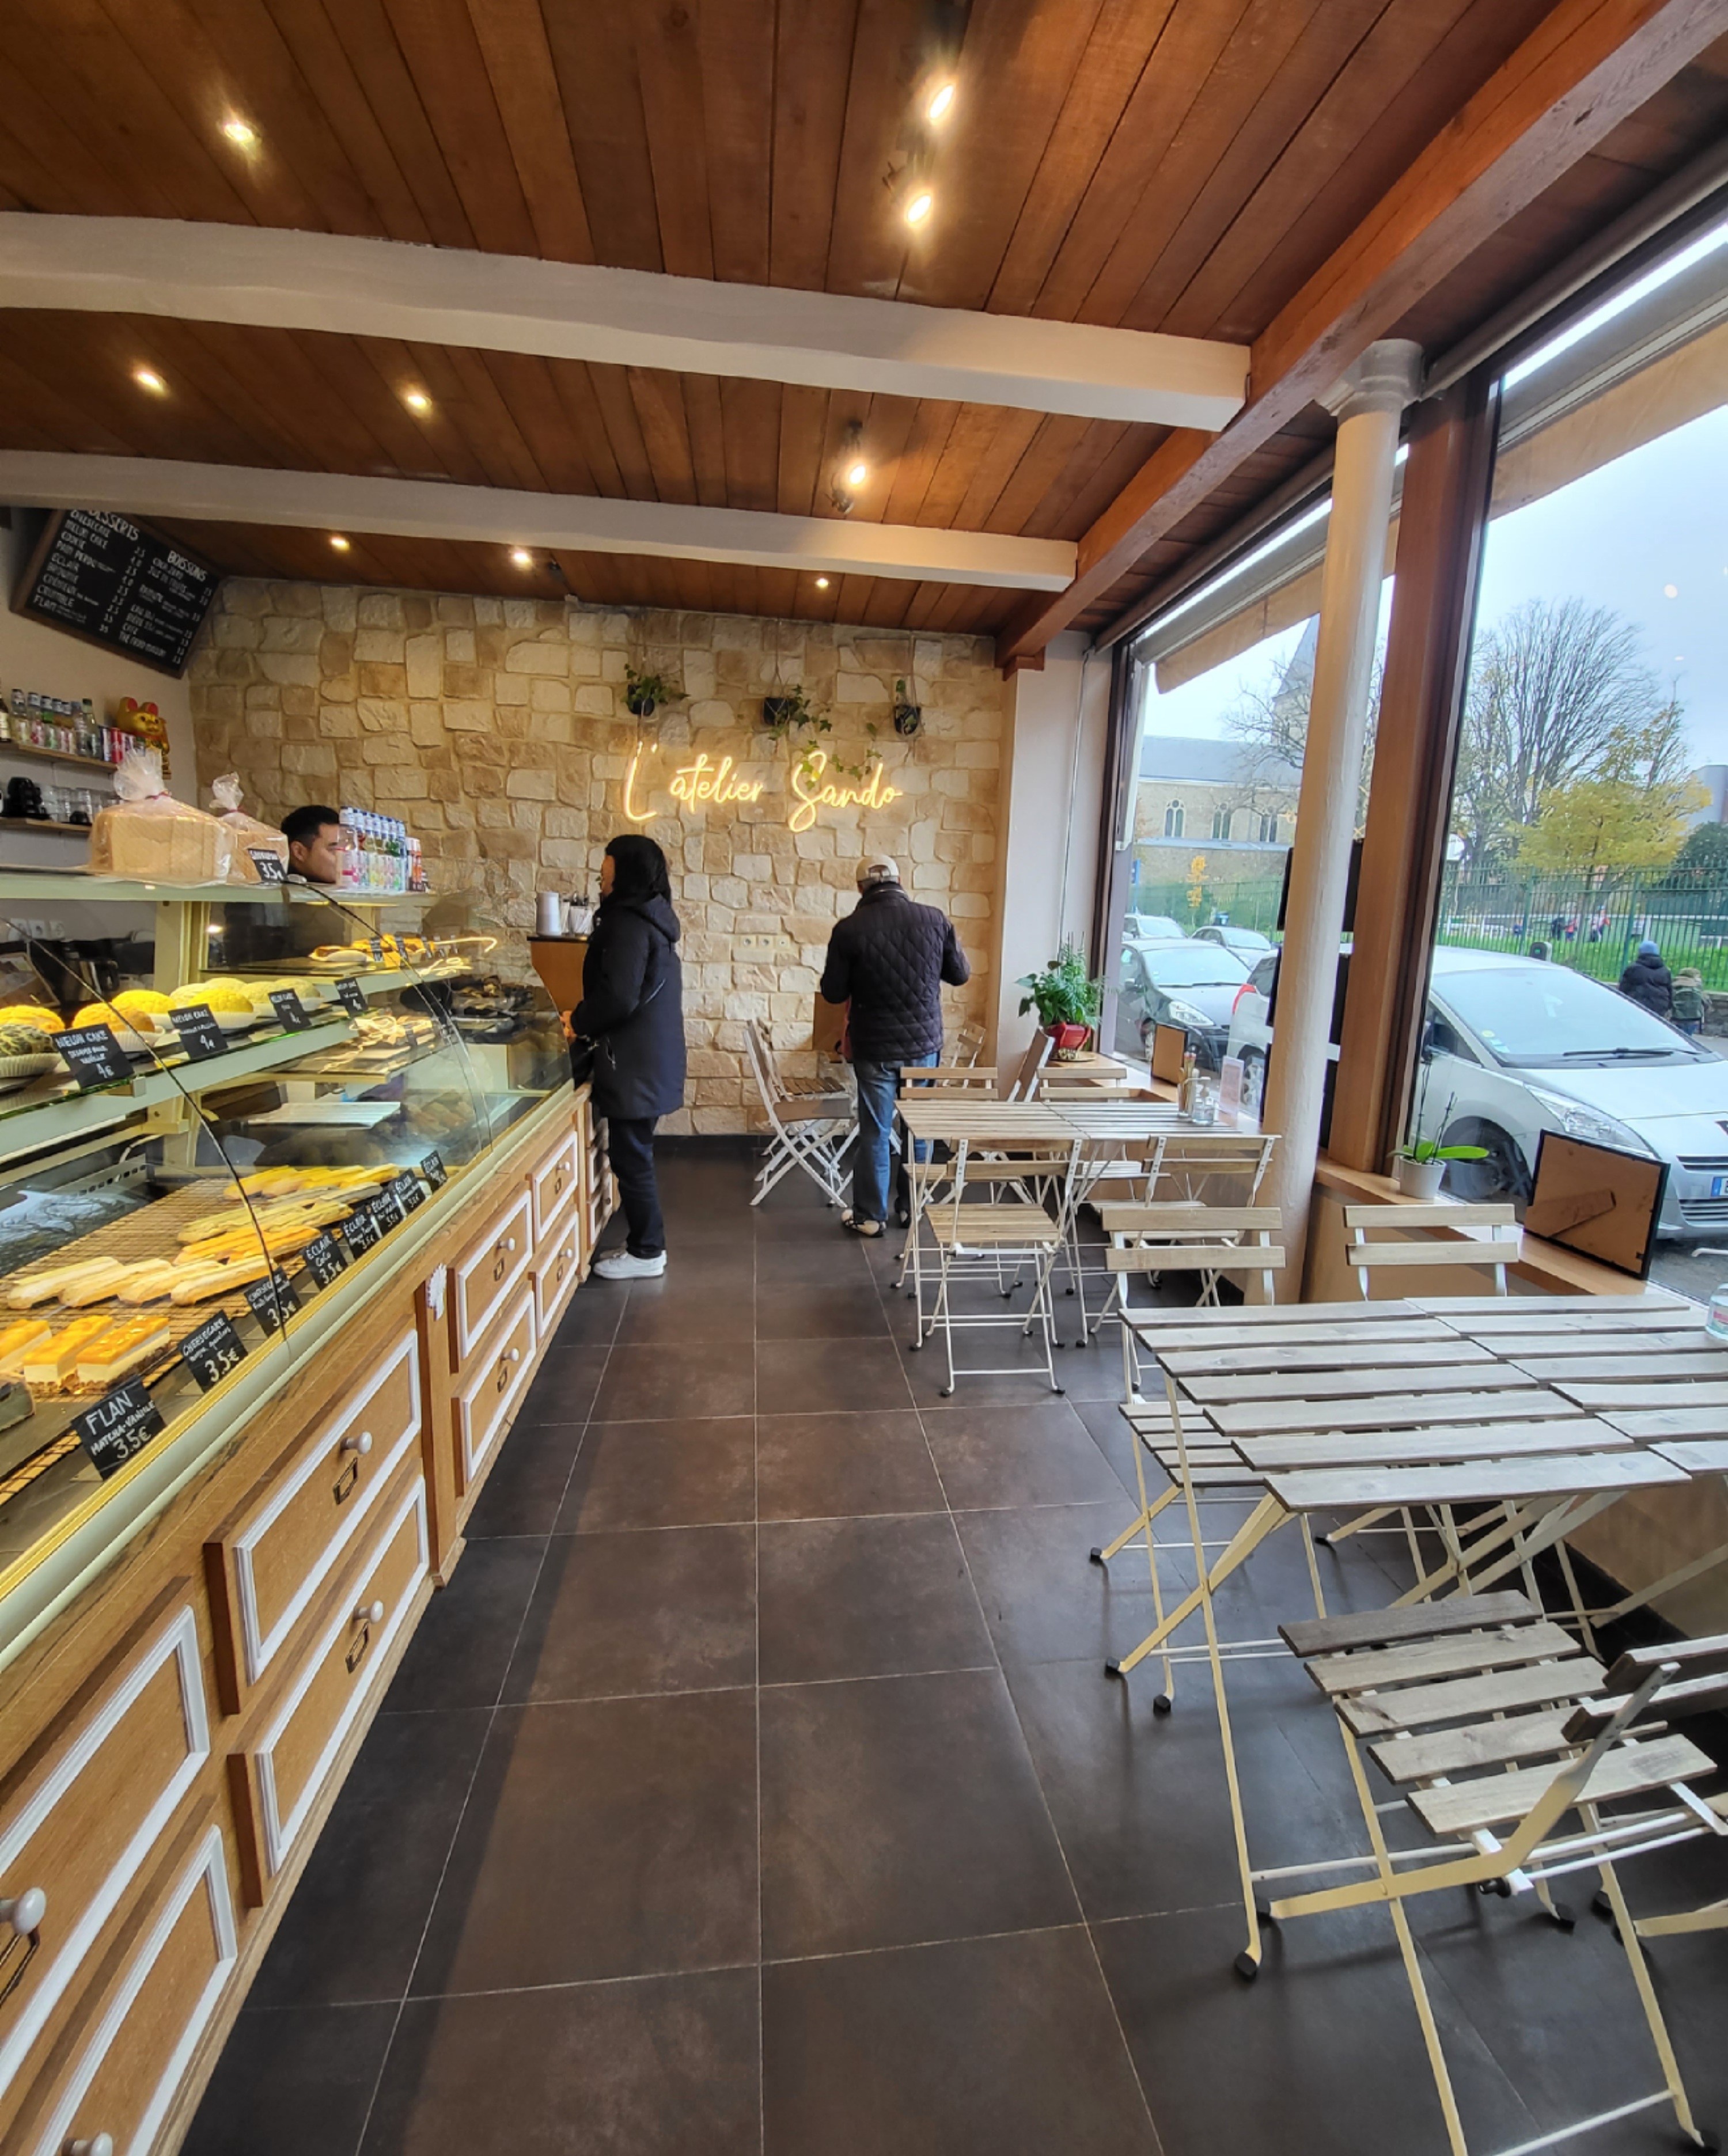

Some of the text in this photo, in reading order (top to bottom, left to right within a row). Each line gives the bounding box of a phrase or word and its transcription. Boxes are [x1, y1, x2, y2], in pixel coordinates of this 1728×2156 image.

[89, 510, 140, 541] ESSERTS
[167, 549, 207, 582] BOISSONS
[787, 750, 904, 833] Sando
[55, 1030, 109, 1047] MELON CAKE
[96, 1063, 115, 1079] 4€
[319, 1260, 343, 1284] 3.5€
[183, 1317, 226, 1356] CHEESECAKE
[204, 1348, 239, 1382] 3.5€
[85, 1390, 133, 1435] FLAN
[113, 1426, 151, 1459] 3.5€
